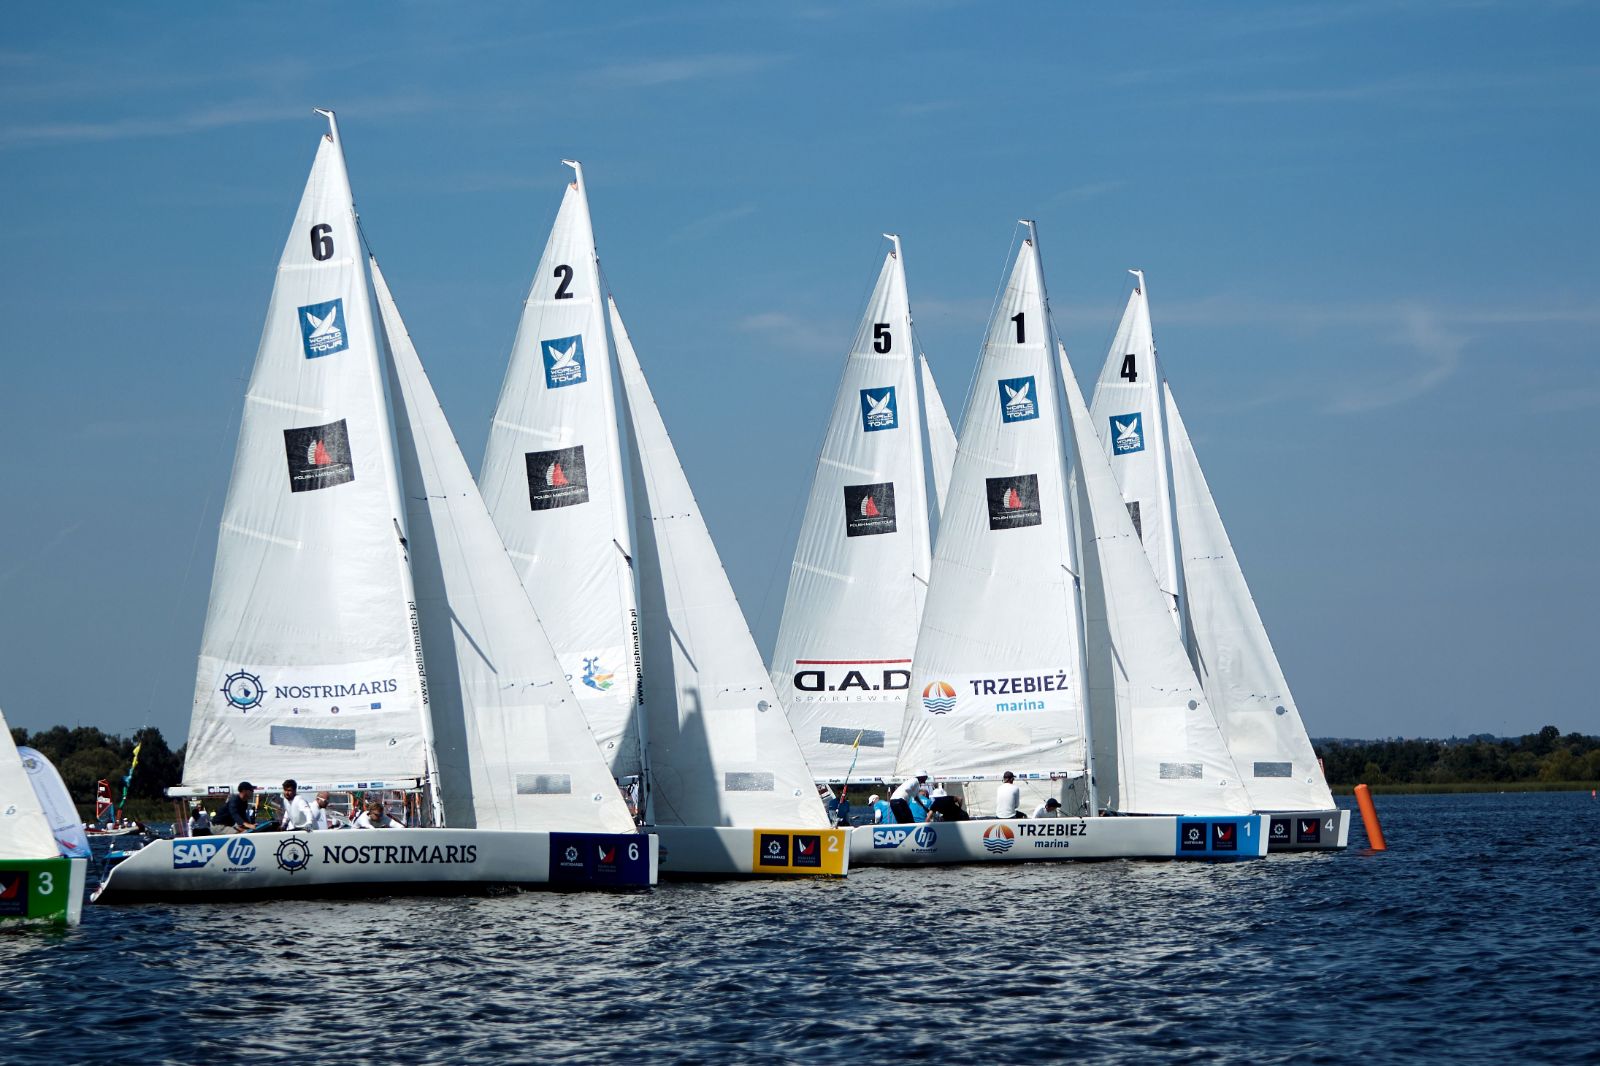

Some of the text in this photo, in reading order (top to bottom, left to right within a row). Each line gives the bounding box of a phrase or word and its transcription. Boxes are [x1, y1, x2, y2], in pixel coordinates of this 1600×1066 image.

[310, 223, 335, 262] 6
[553, 264, 574, 300] 2
[309, 331, 341, 343] WORLD
[1011, 312, 1025, 344] 1
[310, 339, 343, 352] TOUR
[873, 323, 892, 354] 5
[550, 365, 581, 374] WORLD
[551, 372, 582, 383] TOUR
[1120, 353, 1138, 383] 4
[1006, 409, 1034, 418] TOUR
[408, 601, 429, 705] www.polishmatch.pl
[629, 608, 644, 706] www.polishmatch.pl
[275, 678, 398, 699] NOSTRIMARIS
[969, 669, 1069, 696] TRZEBIEŻ
[996, 699, 1045, 713] marina
[1017, 820, 1087, 837] TRZEBIEŻ
[1244, 822, 1251, 837] 1
[1324, 818, 1334, 832] 4
[827, 835, 839, 852] 2
[873, 830, 907, 846] SAP
[917, 827, 935, 848] hp
[1034, 838, 1069, 848] marina
[173, 843, 217, 864] SAP
[230, 837, 254, 866] hp
[323, 845, 477, 864] NOSTRIMARIS
[628, 842, 639, 861] 6
[38, 871, 54, 895] 3
